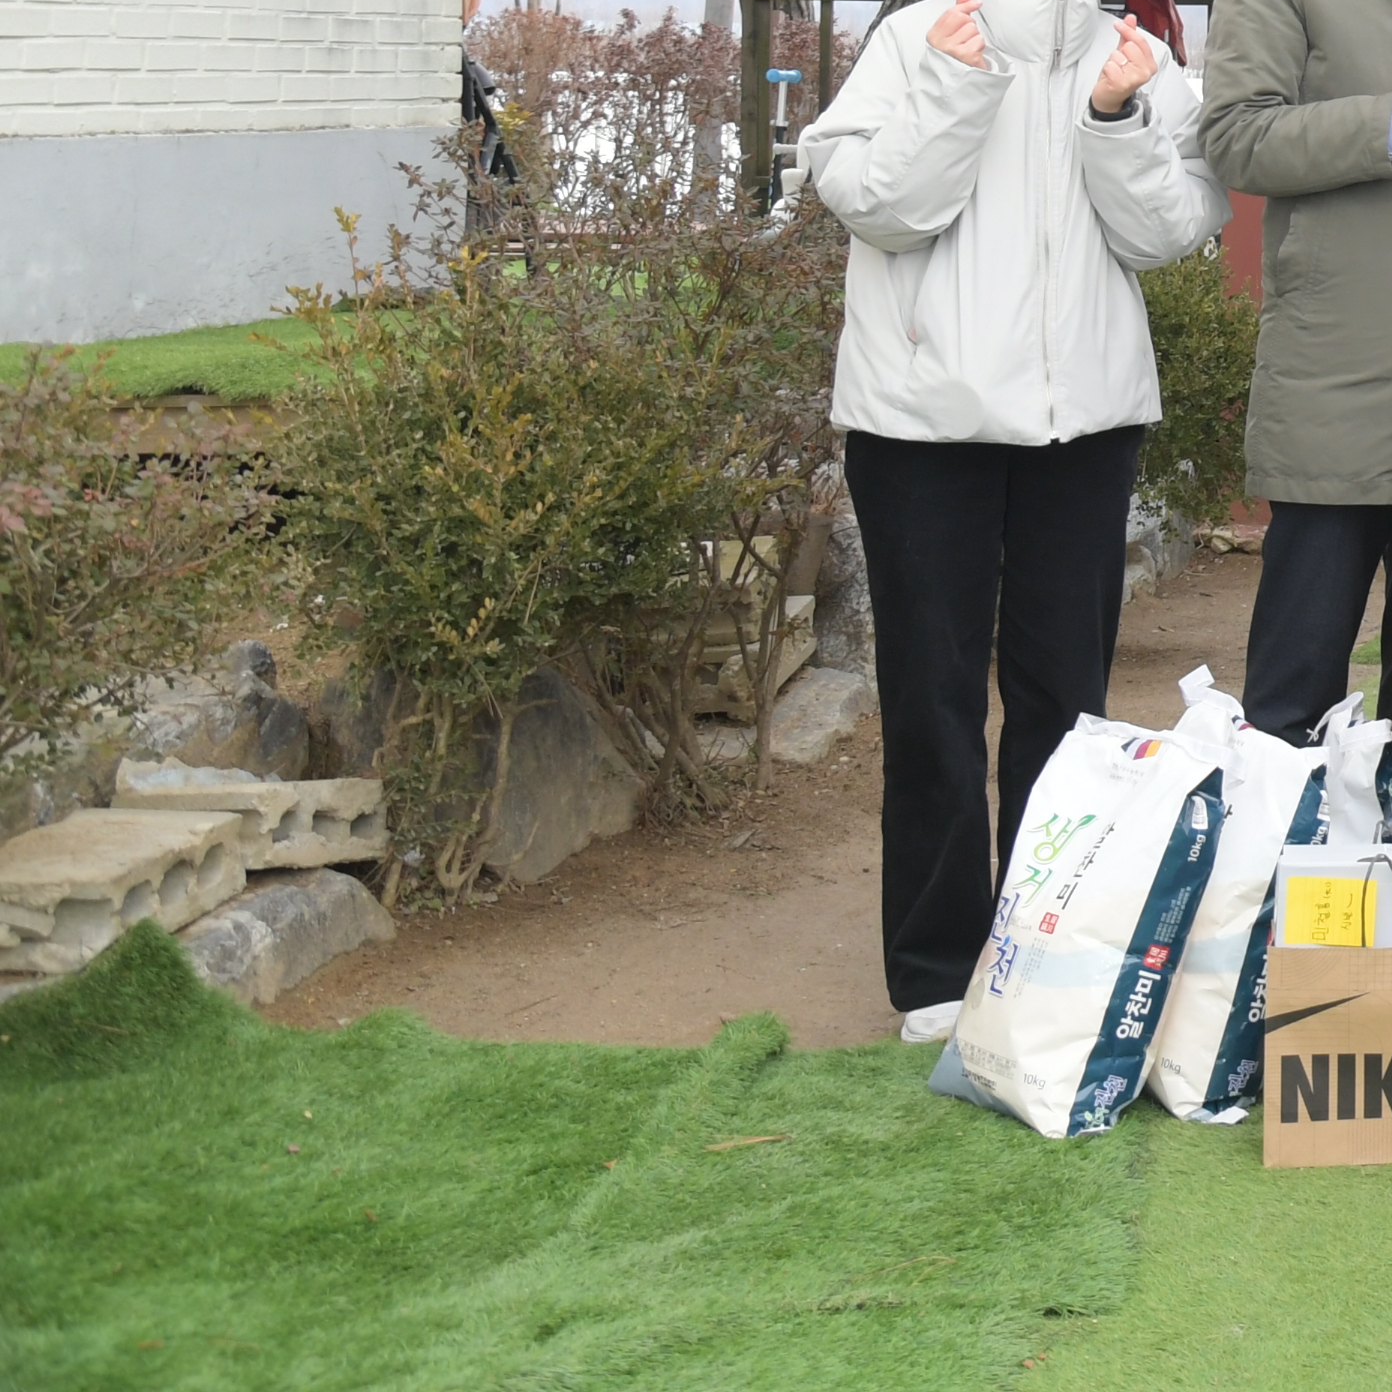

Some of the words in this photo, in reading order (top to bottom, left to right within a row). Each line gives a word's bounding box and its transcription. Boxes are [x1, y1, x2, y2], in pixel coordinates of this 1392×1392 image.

[1314, 824, 1329, 846] 0kg
[1188, 833, 1206, 864] 10kg
[1116, 970, 1161, 1040] 알찬미
[1160, 1056, 1182, 1075] 10kg
[1023, 1072, 1047, 1090] 10kg
